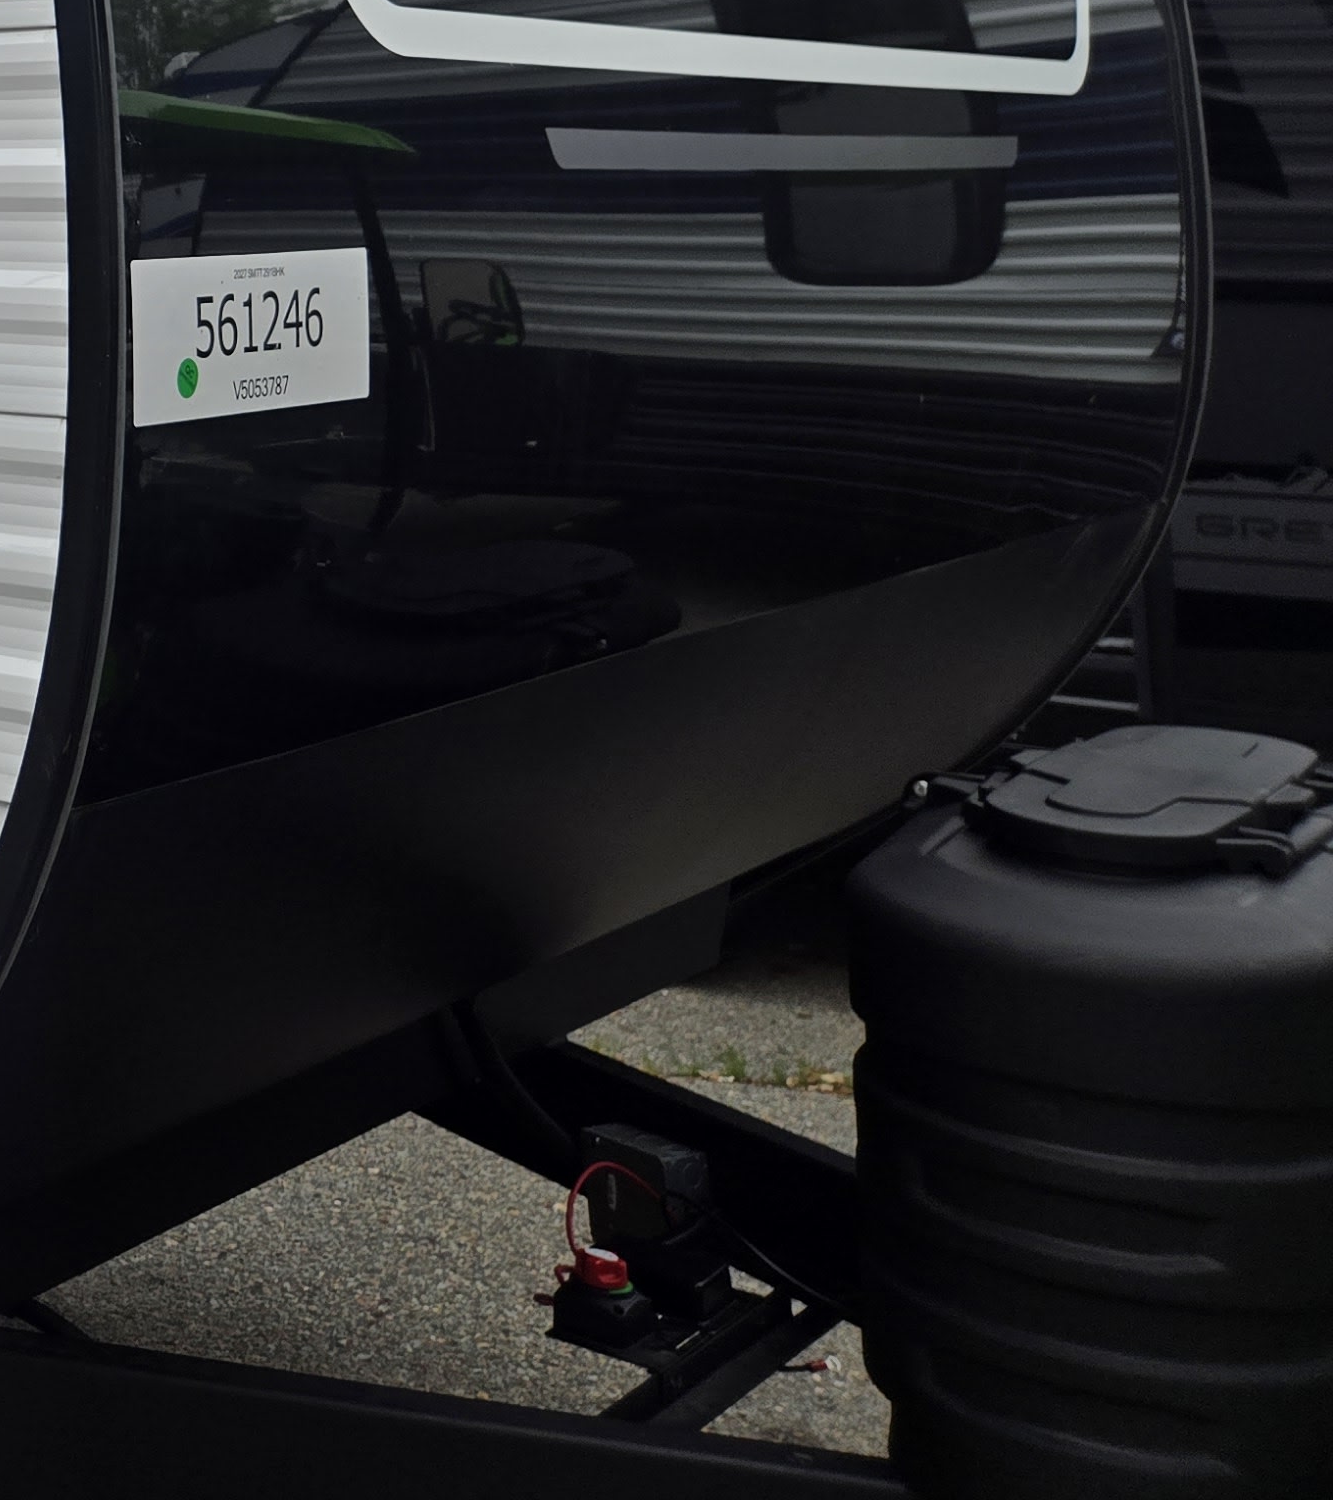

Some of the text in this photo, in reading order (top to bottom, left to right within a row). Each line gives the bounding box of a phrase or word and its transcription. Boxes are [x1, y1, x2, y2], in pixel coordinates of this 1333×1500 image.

[195, 286, 324, 359] 561246
[233, 374, 290, 400] V5053787
[1195, 513, 1333, 546] GRE
